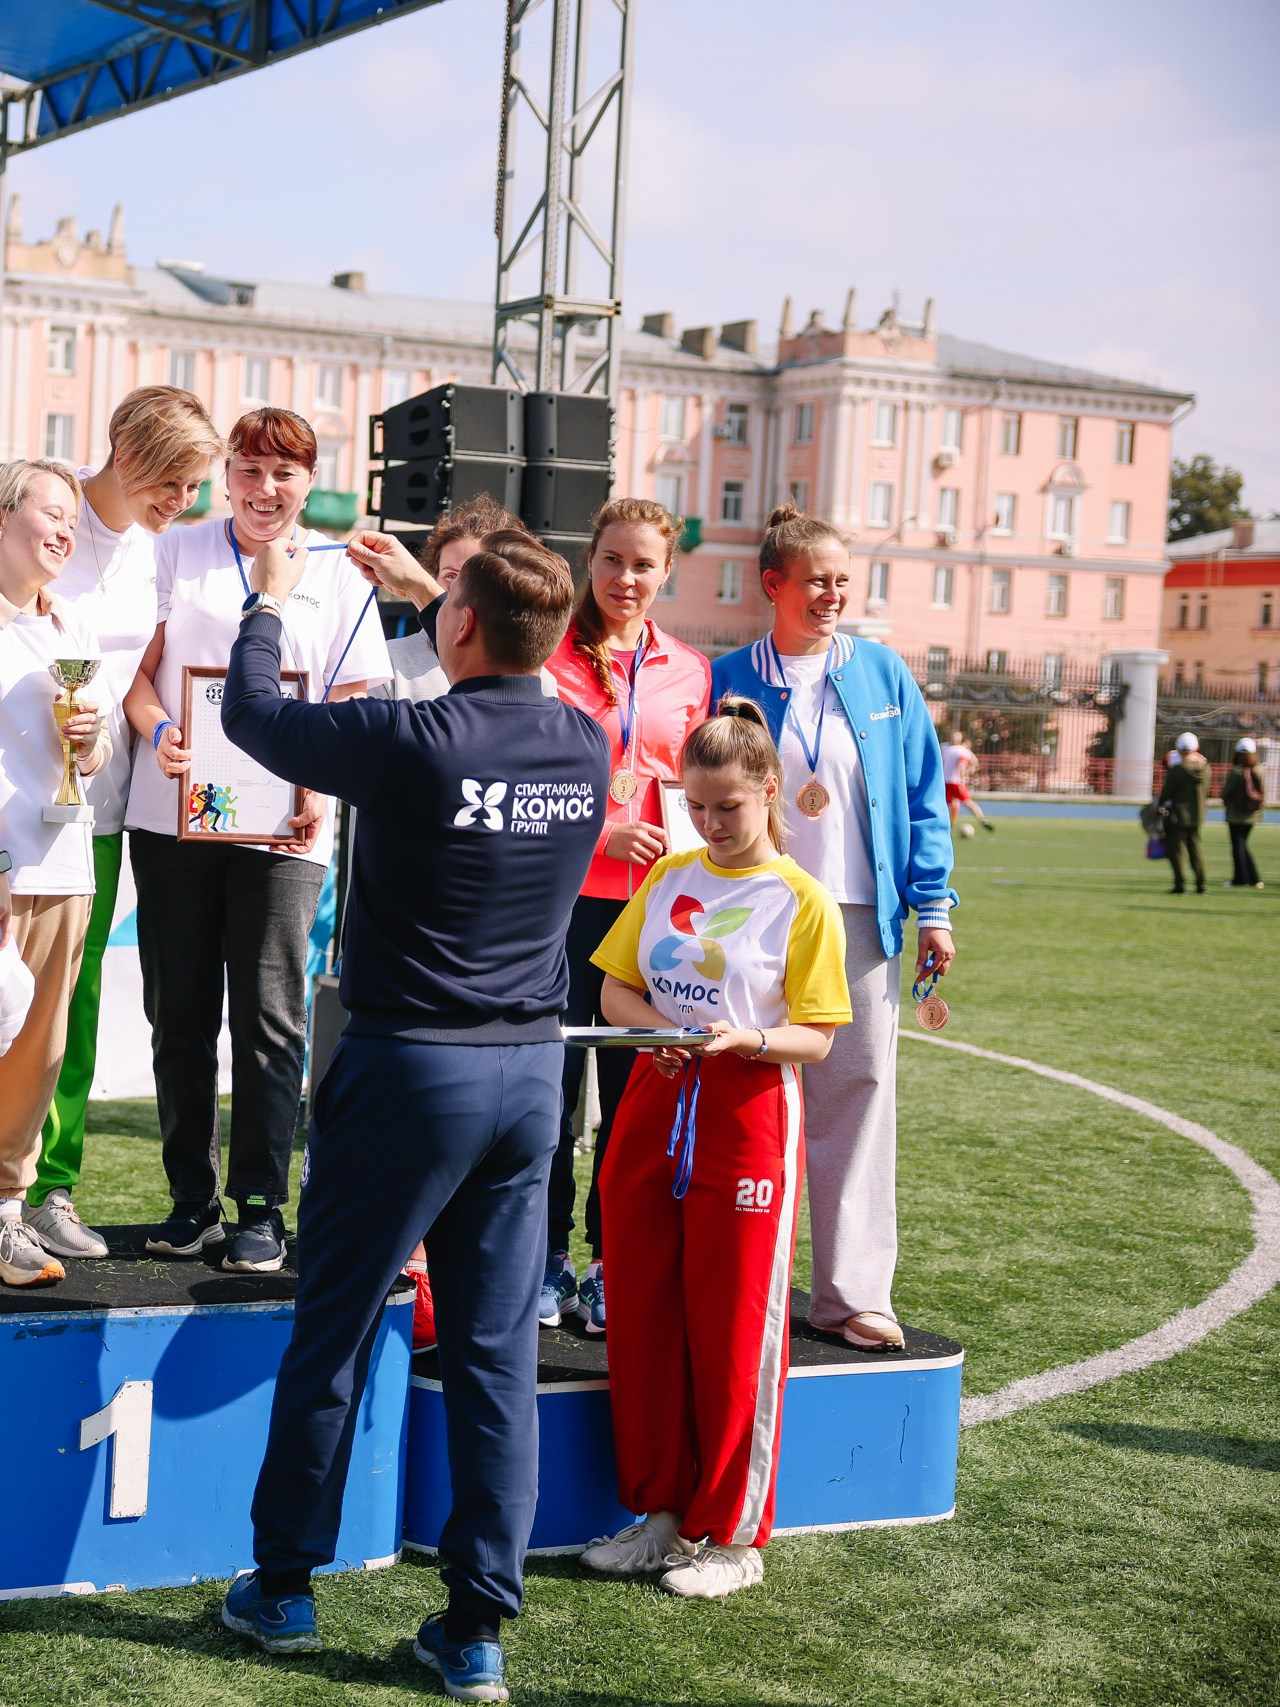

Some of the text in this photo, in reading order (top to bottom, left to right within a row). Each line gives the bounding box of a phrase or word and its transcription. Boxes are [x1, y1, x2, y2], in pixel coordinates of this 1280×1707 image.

[514, 783, 593, 798] СПАРТАКИАДА
[511, 796, 595, 821] КОМОС
[510, 820, 549, 835] ГРУПП
[736, 1177, 774, 1208] 20
[79, 1380, 154, 1518] 1
